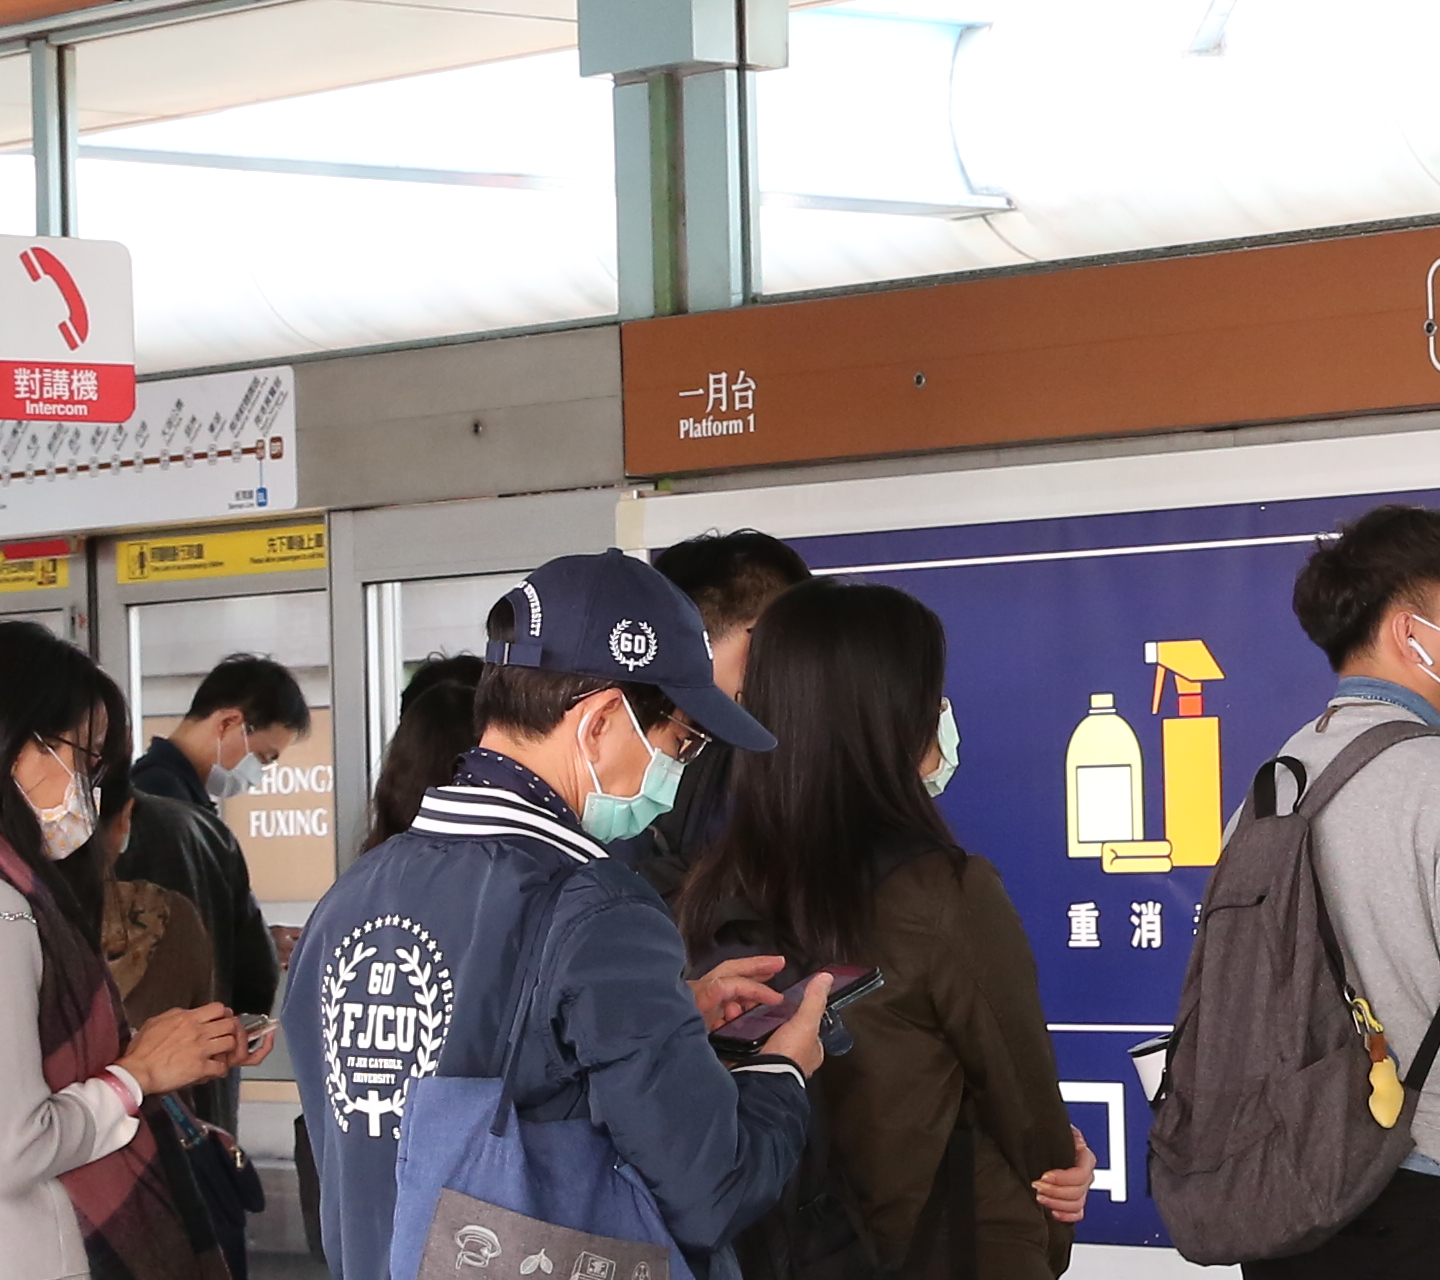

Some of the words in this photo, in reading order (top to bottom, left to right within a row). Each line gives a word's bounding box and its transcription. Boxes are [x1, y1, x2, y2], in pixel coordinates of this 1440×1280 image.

[14, 368, 99, 401] 對講機
[678, 370, 757, 413] 一月台
[25, 400, 88, 416] Intercom
[679, 415, 743, 439] Platform
[747, 413, 755, 432] 1
[620, 633, 646, 654] 60
[249, 807, 328, 838] FUXING
[367, 962, 396, 996] 60
[340, 1003, 418, 1053] FJCU
